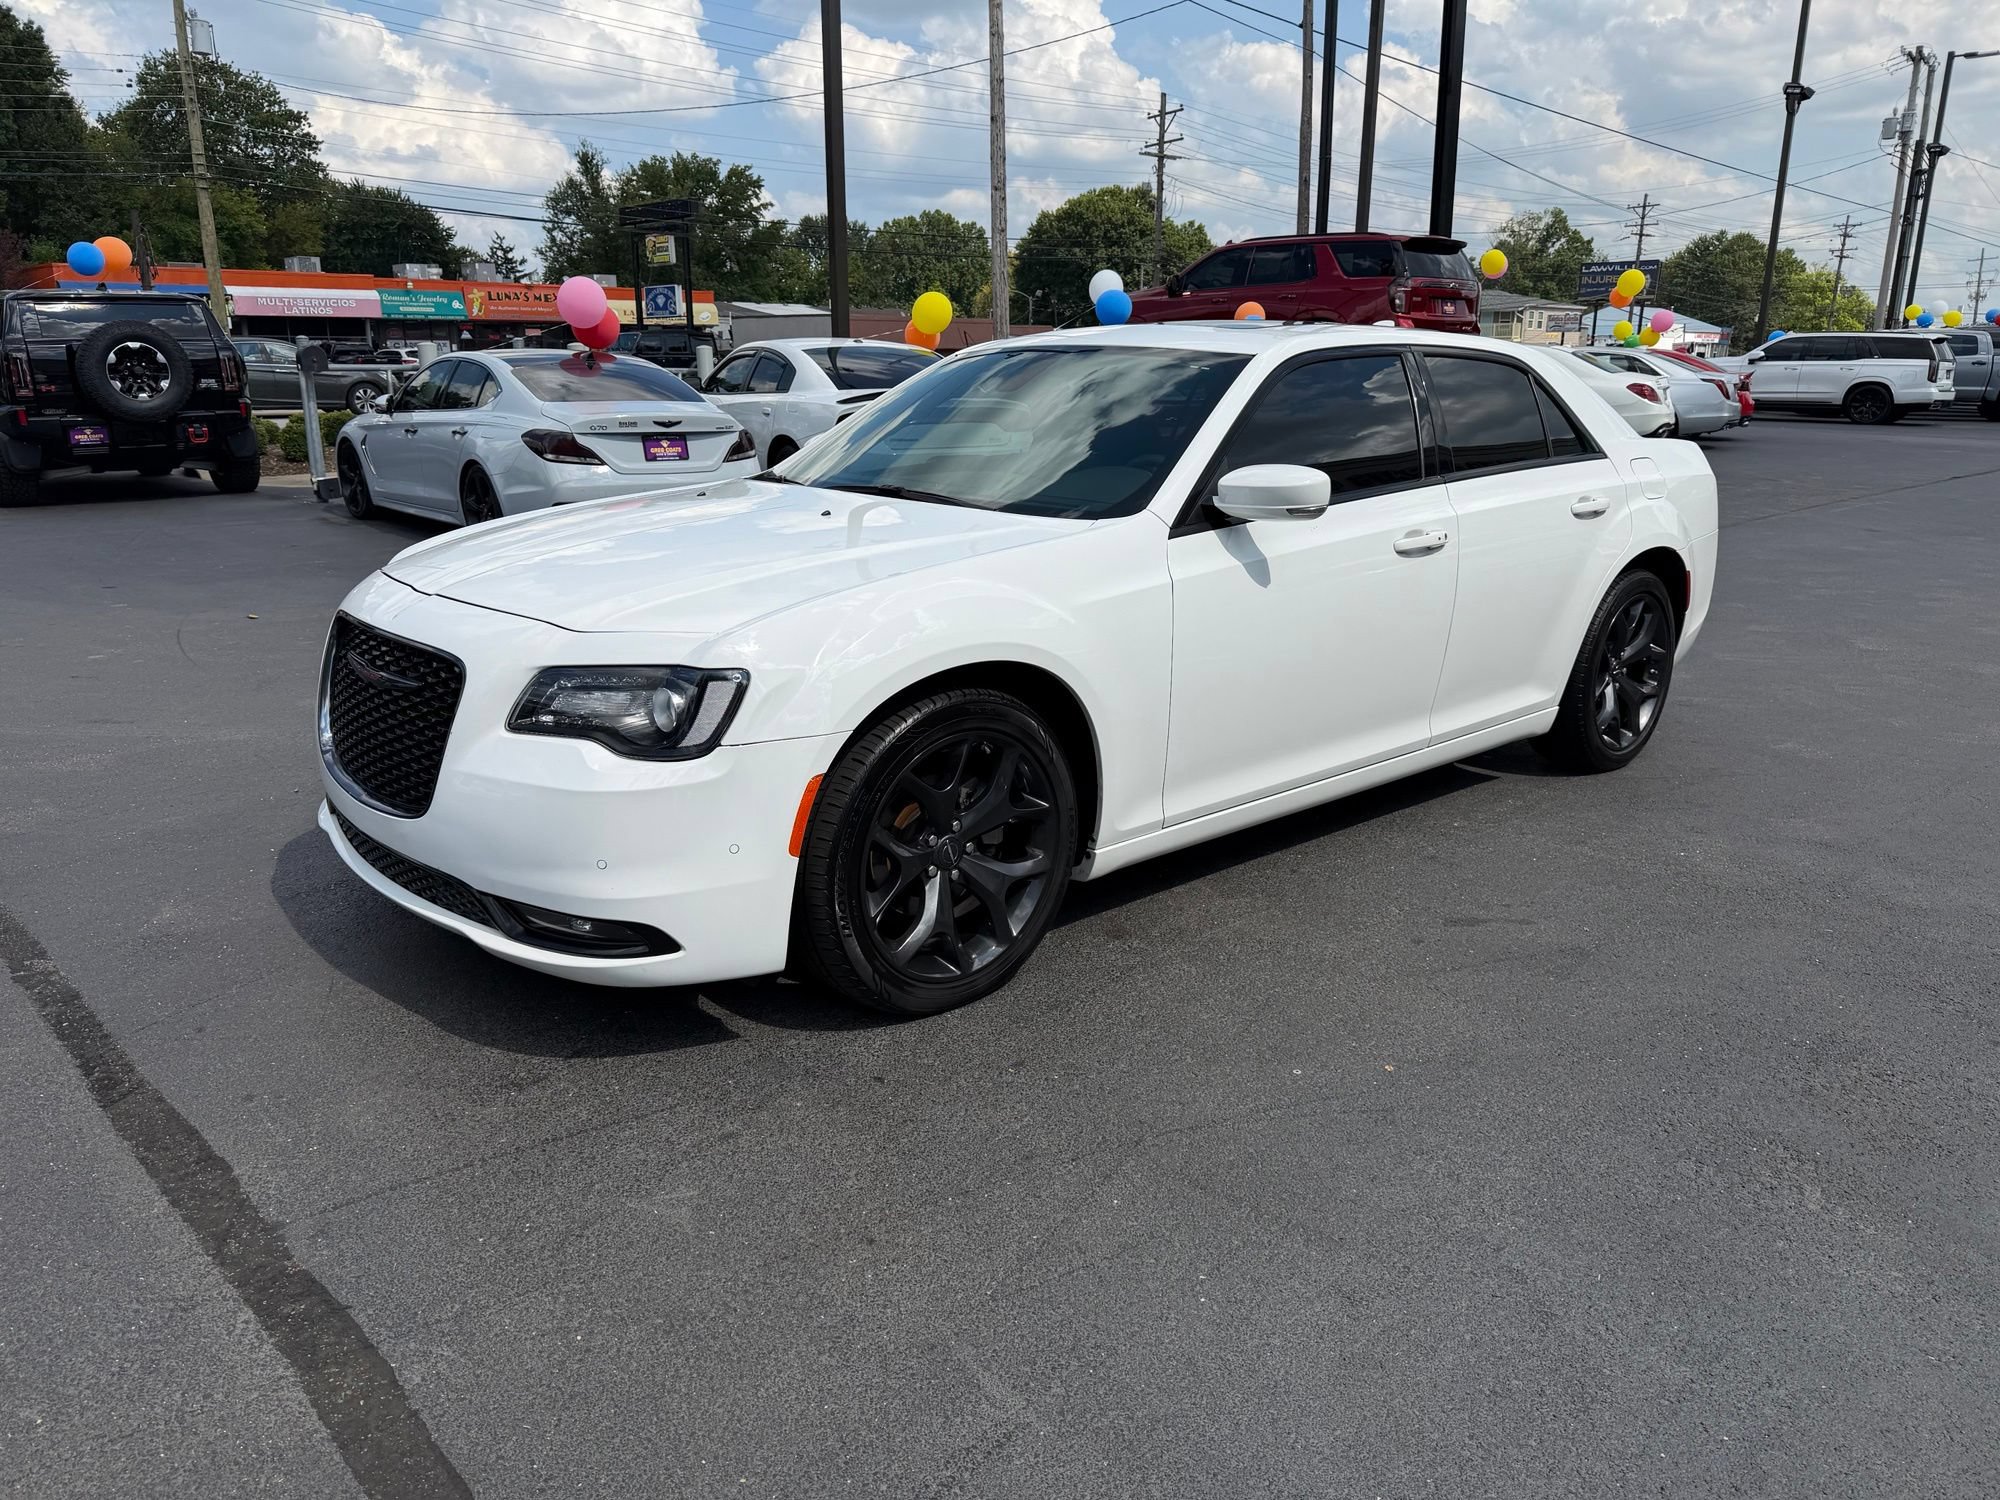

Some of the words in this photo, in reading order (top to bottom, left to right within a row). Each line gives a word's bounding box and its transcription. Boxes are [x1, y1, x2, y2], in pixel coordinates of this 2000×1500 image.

[1582, 264, 1657, 272] LAWVILL.COM
[487, 291, 530, 302] LUNA'S
[257, 297, 357, 307] MULTI-SERVICIOS
[284, 306, 334, 314] LATINOS
